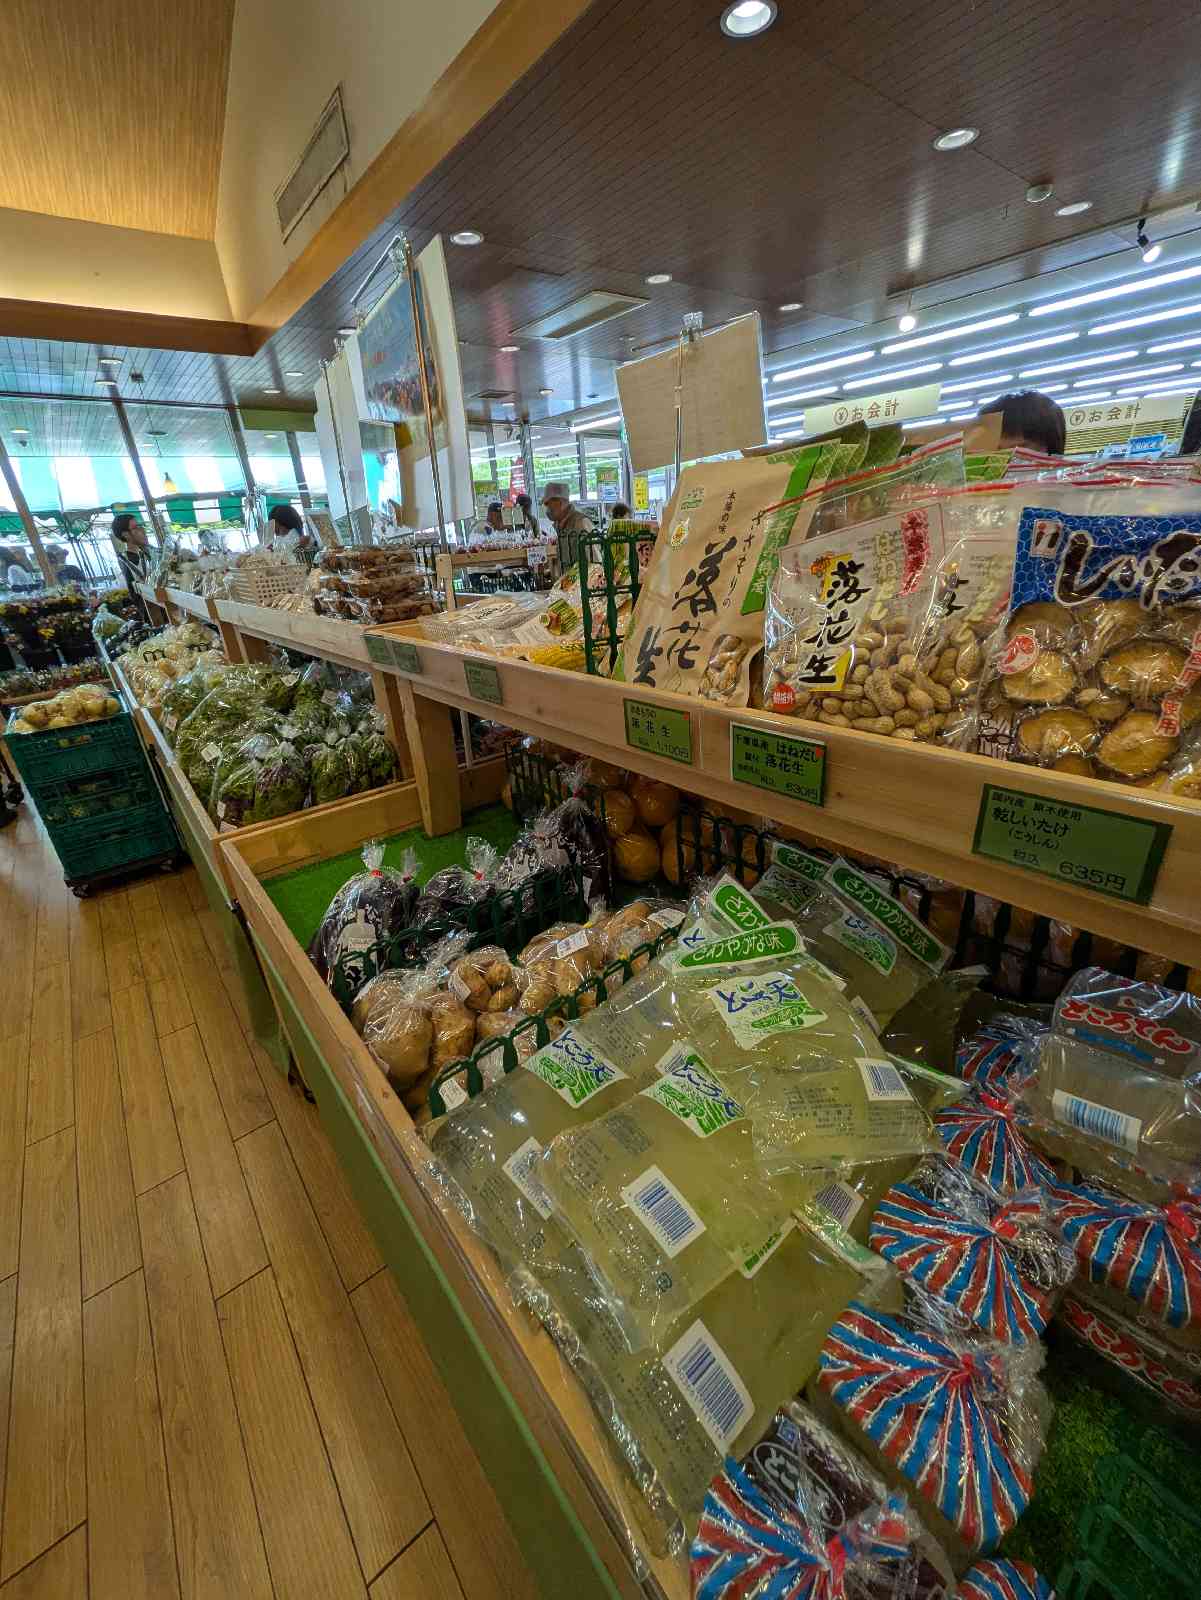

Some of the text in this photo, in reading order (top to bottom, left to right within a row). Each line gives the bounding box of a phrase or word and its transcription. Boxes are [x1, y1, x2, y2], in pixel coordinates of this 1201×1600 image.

[851, 399, 899, 421] お会計
[1088, 403, 1141, 423] お会計
[798, 559, 873, 684] 落花生
[766, 754, 806, 776] 落花生
[776, 741, 819, 763] はねだし
[992, 807, 1070, 838] 乾しいたけ
[1032, 802, 1083, 821] 原木使用
[1058, 860, 1128, 891] 635円
[843, 878, 930, 954] さわやかな味
[692, 932, 786, 962] さわやかな味
[1060, 999, 1193, 1054] ところてん
